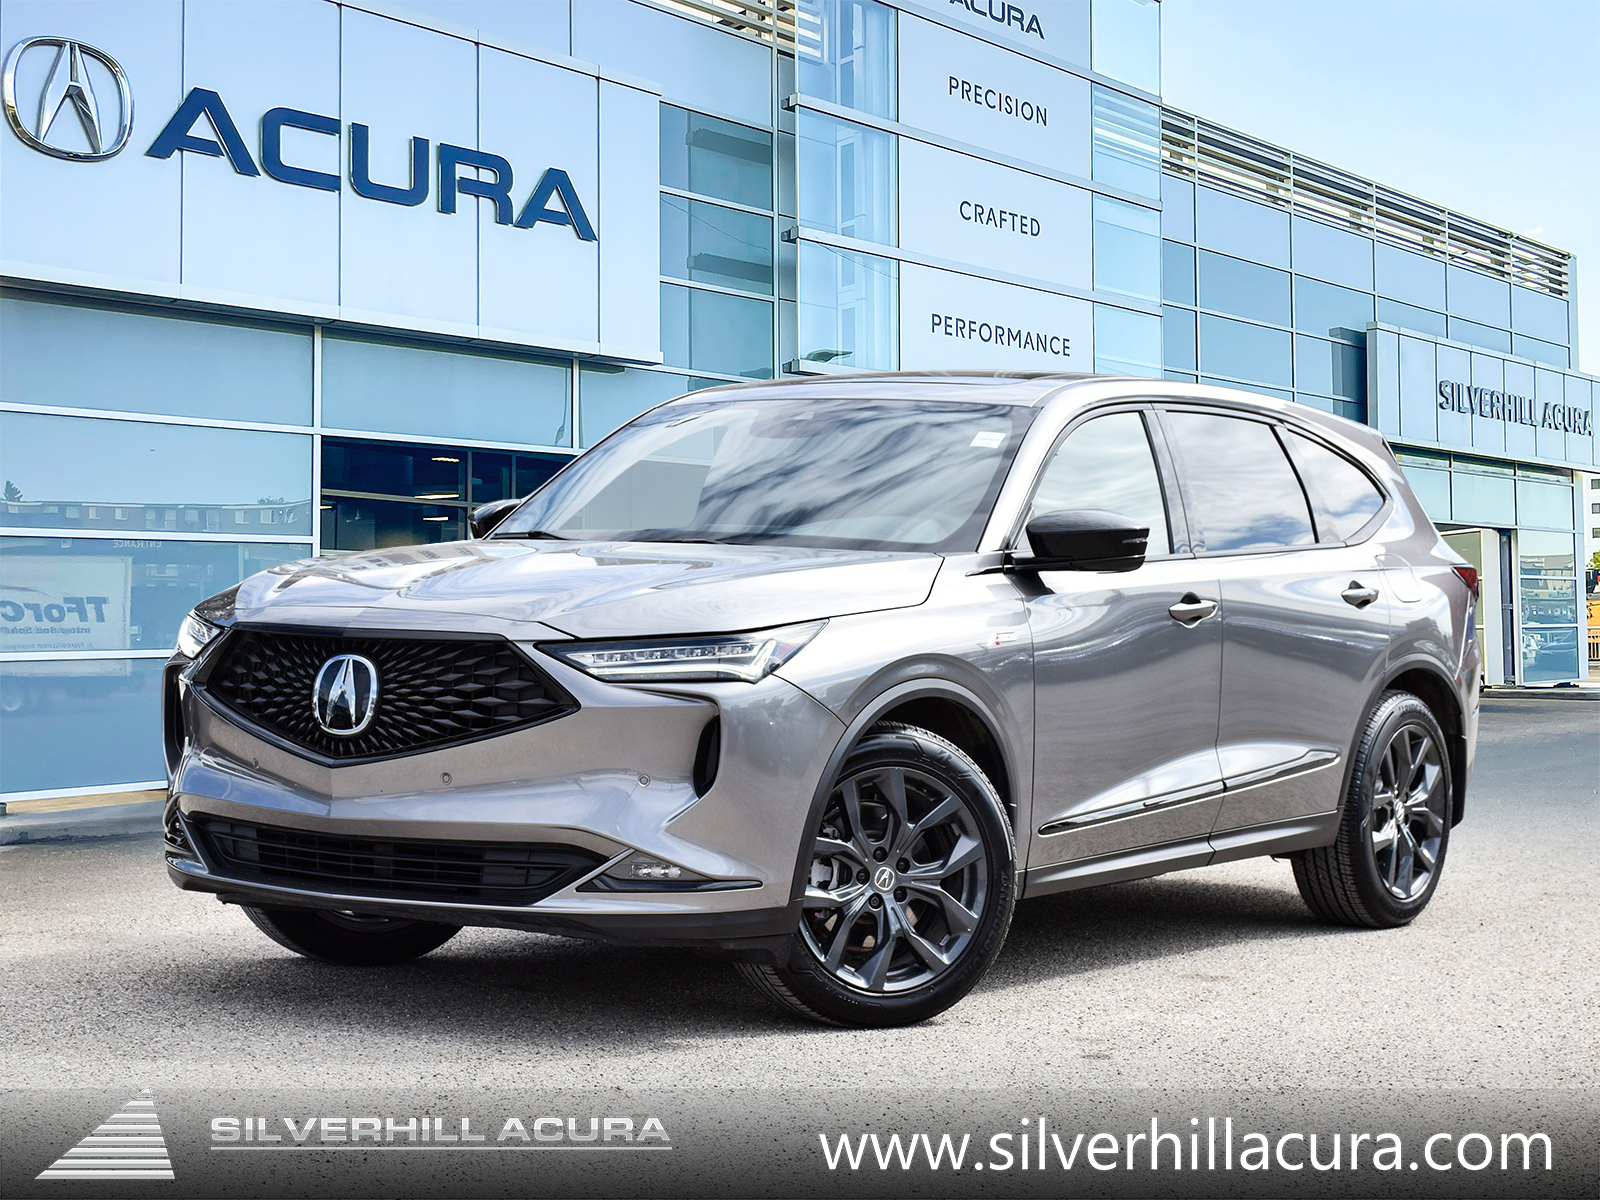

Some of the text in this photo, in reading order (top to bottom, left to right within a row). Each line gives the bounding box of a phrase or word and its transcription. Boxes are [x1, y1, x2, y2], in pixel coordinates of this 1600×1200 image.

[949, 0, 1045, 40] CURA
[948, 75, 1048, 127] PRECISION
[144, 86, 599, 242] ACURA
[959, 200, 1041, 237] CRAFTED
[931, 313, 1071, 357] PERFORMANCE
[1439, 380, 1594, 437] SILVERHILL ACURA
